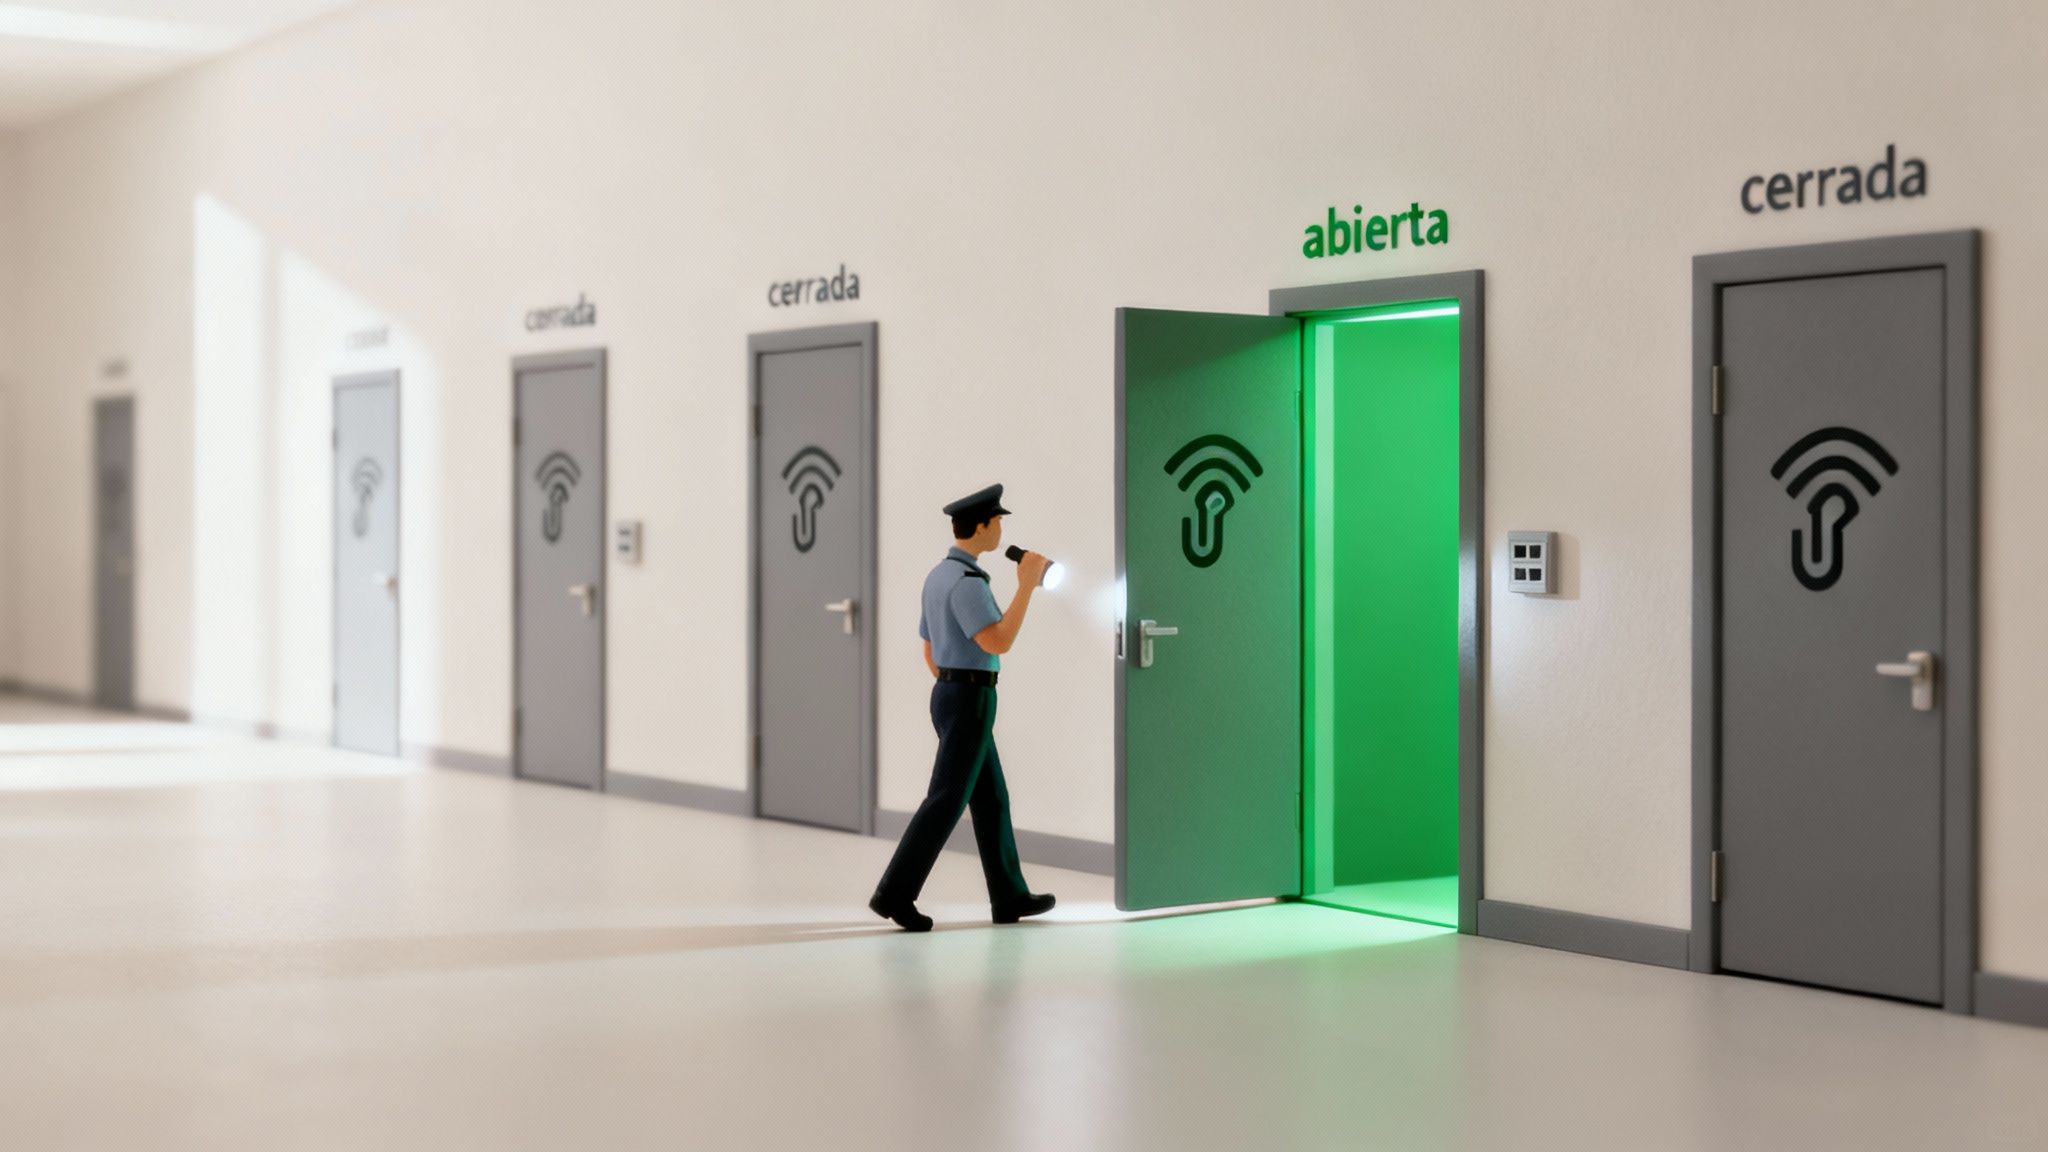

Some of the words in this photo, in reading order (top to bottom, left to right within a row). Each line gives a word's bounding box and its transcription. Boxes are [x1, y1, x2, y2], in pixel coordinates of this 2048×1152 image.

[1741, 144, 1927, 214] cerrada
[1302, 202, 1448, 258] abierta
[767, 263, 860, 307] cerrada
